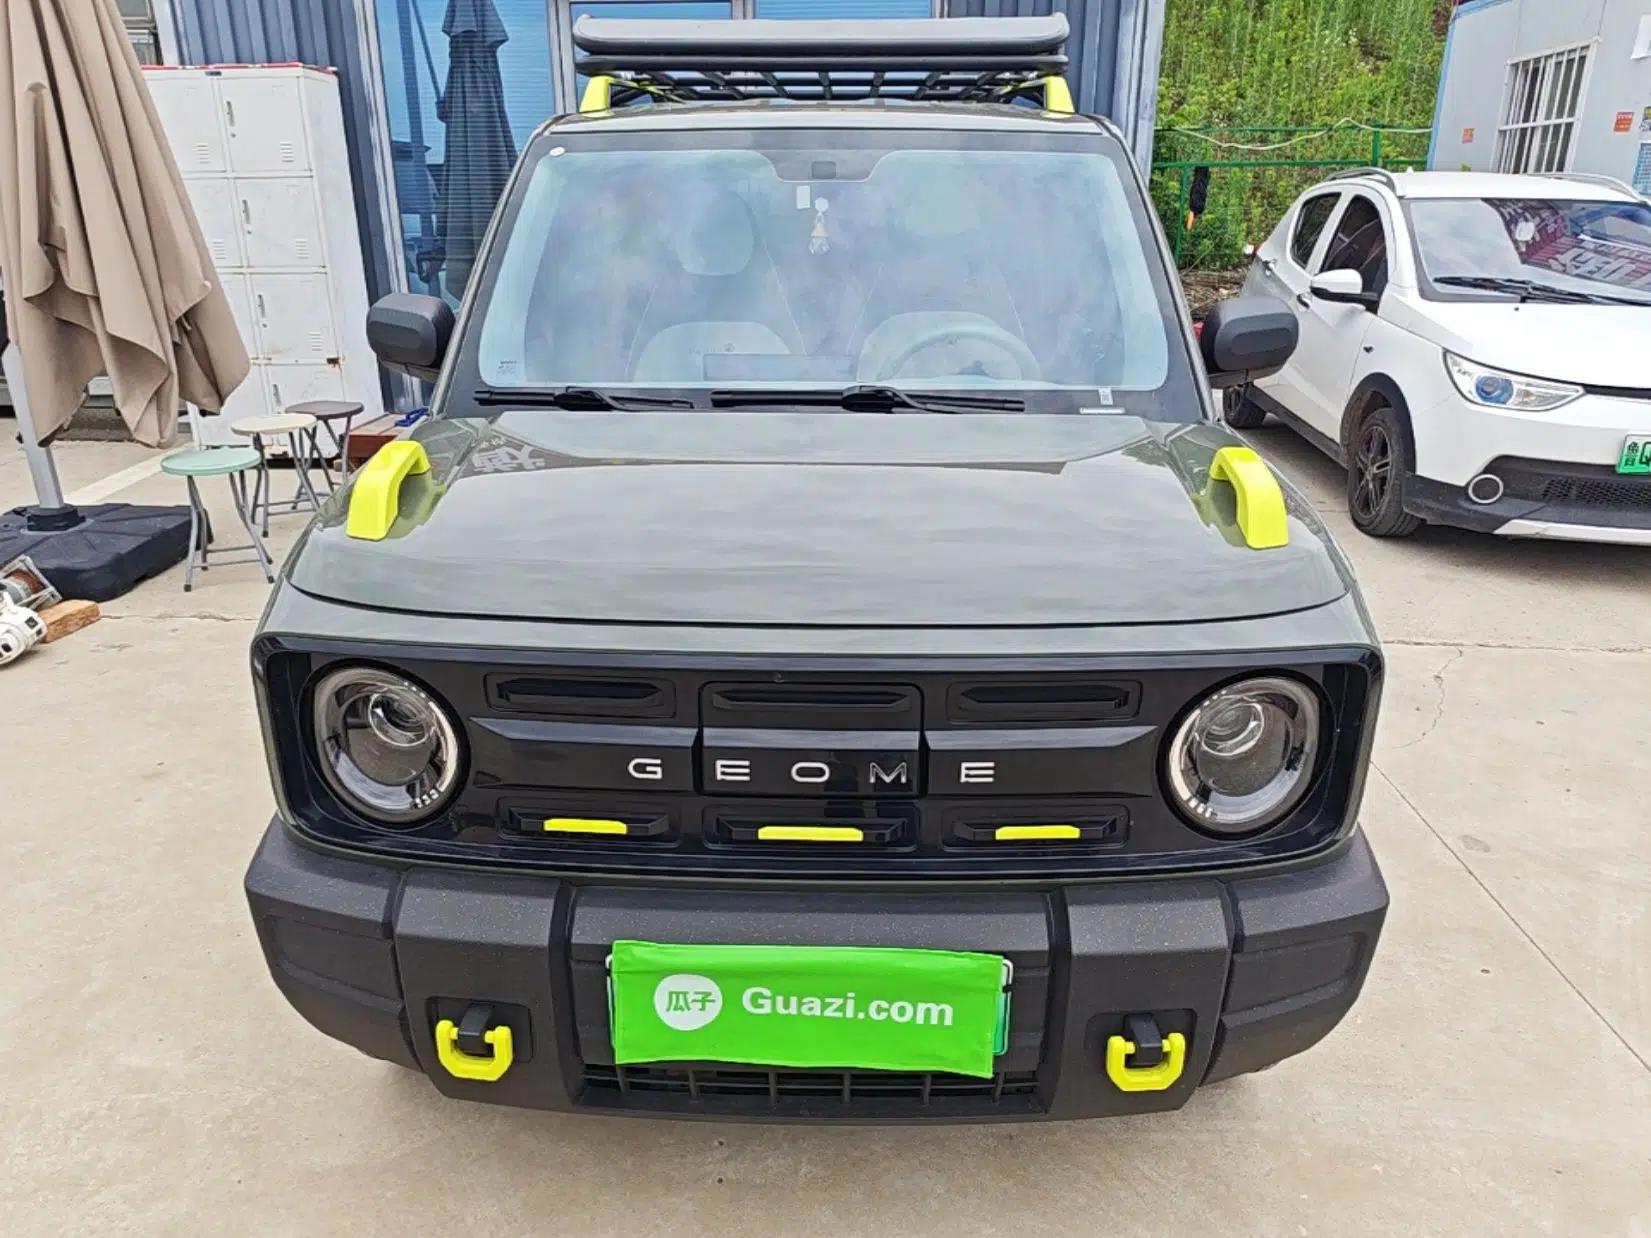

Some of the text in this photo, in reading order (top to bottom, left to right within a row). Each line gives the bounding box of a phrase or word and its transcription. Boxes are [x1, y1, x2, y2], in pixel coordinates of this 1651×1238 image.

[628, 758, 995, 784] GEOME
[666, 990, 716, 1012] 瓜子
[742, 986, 954, 1026] Guazi.com
